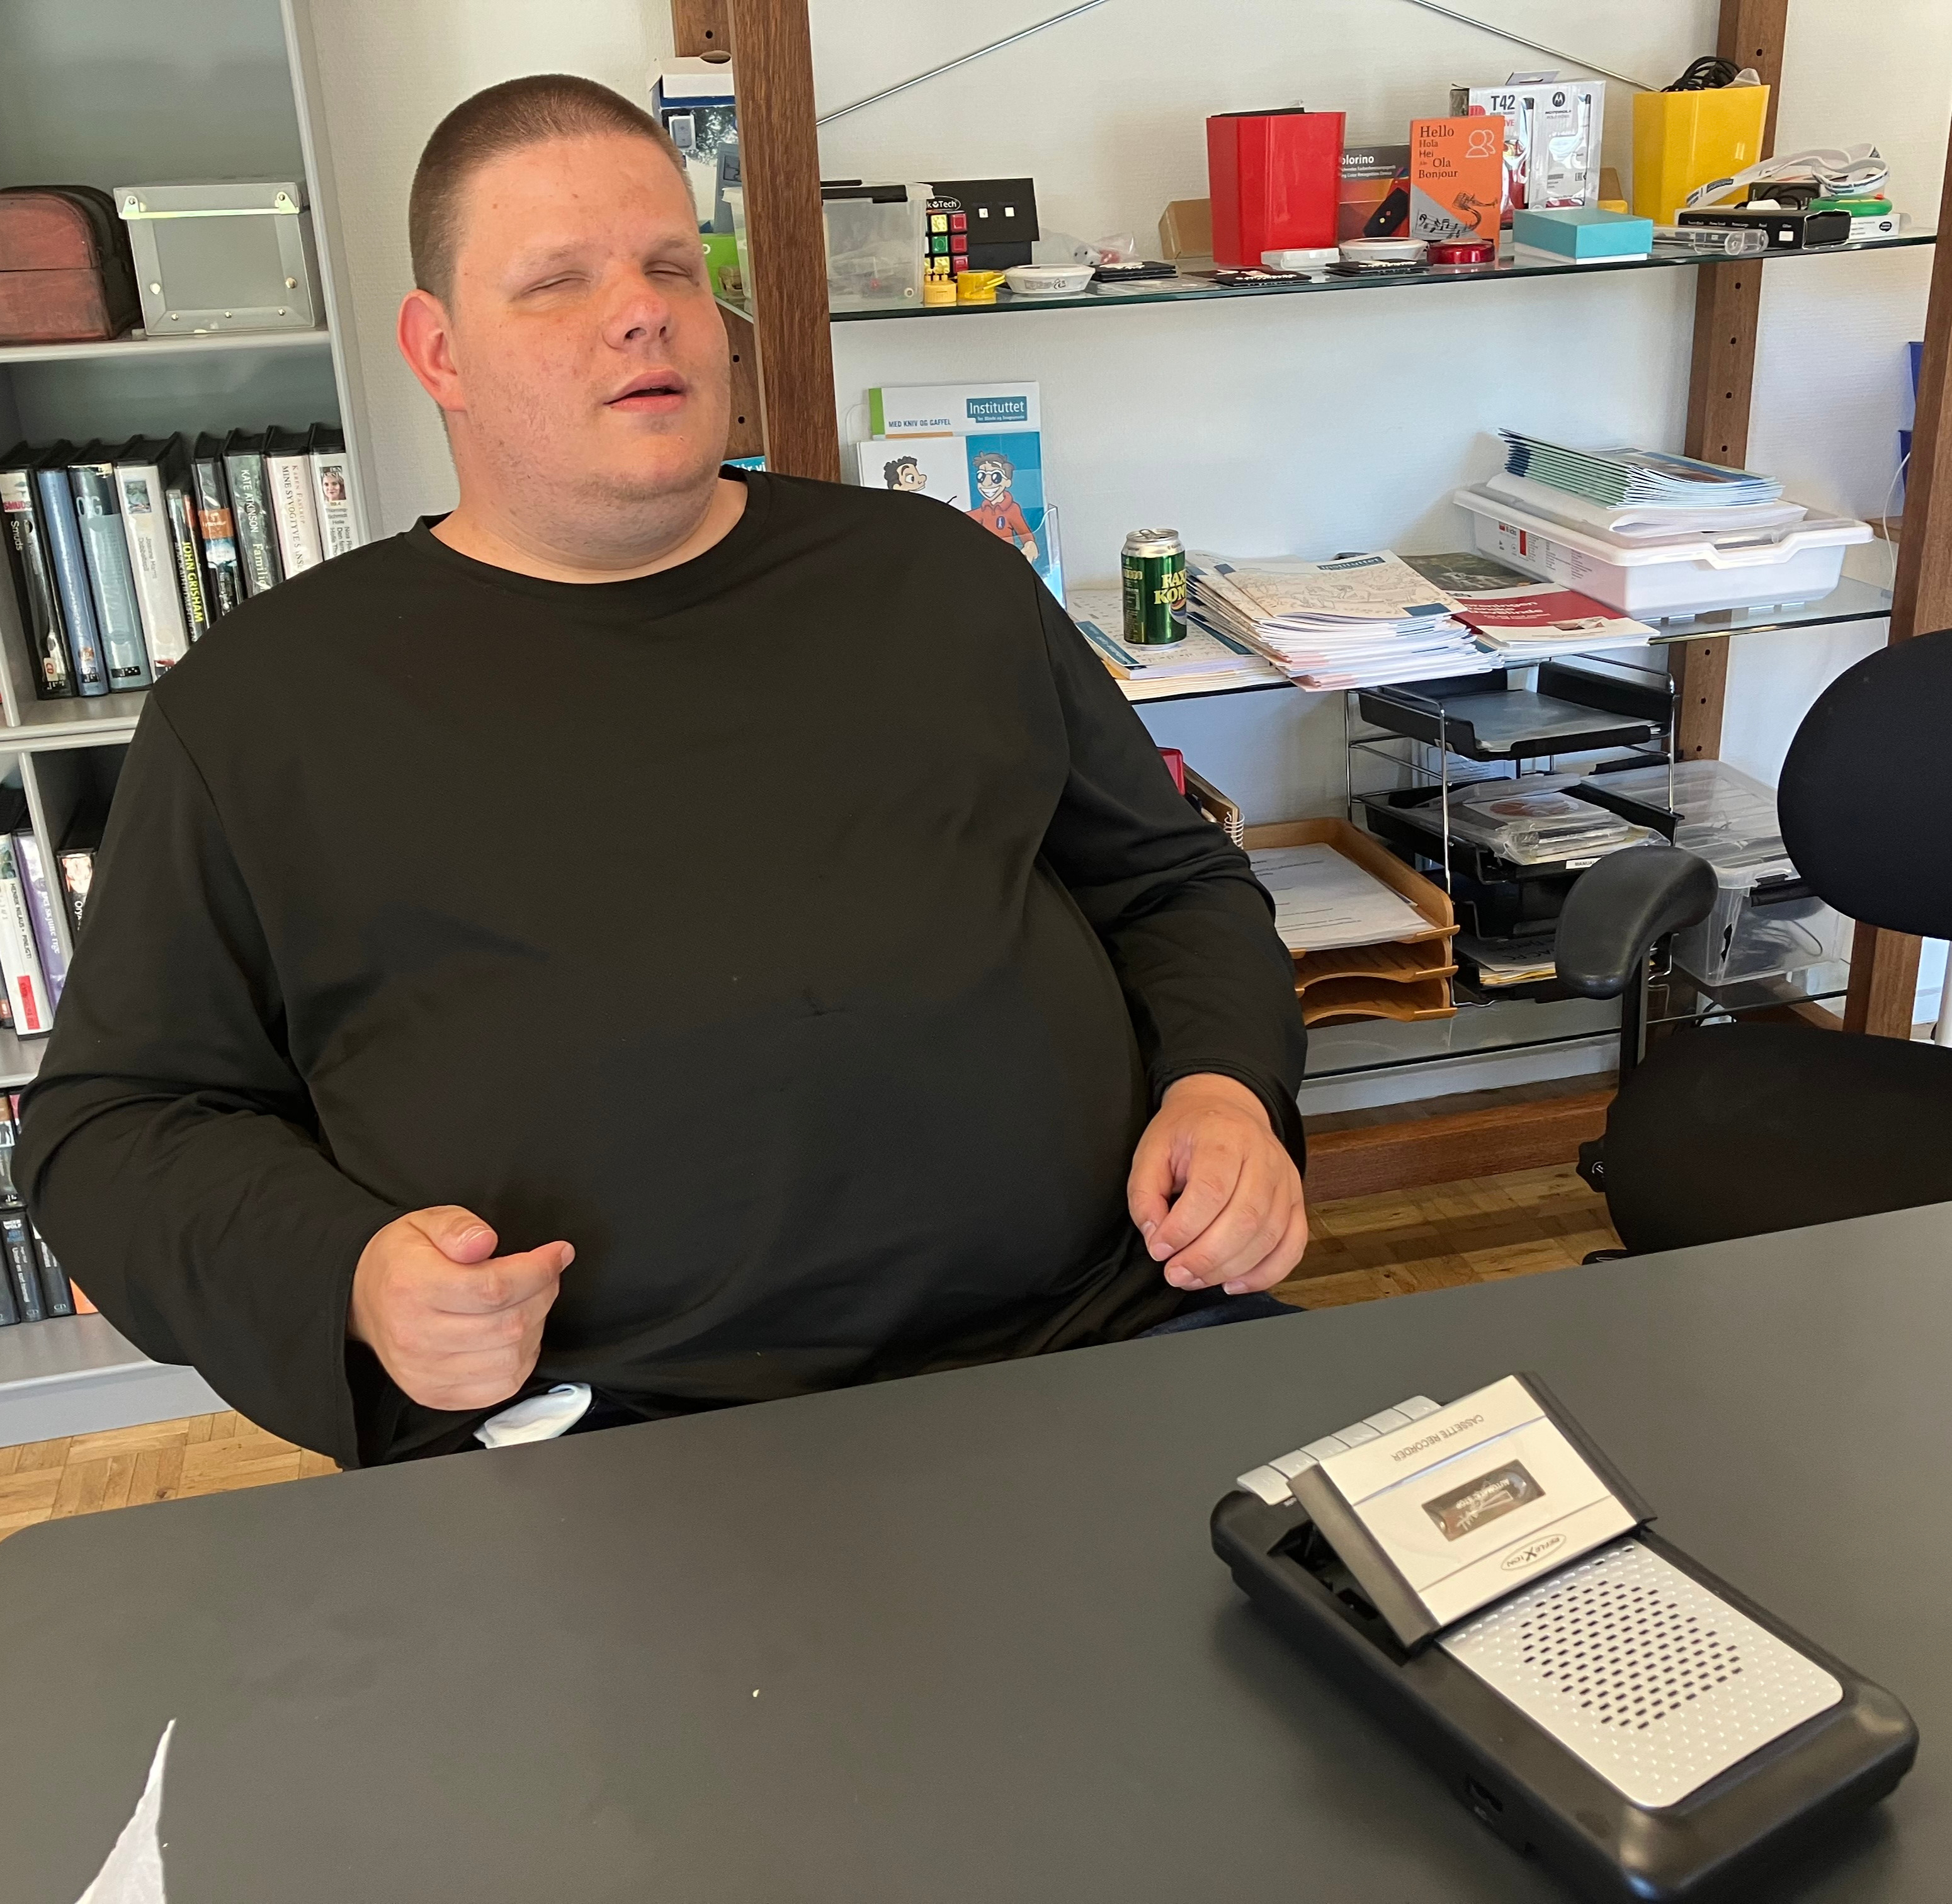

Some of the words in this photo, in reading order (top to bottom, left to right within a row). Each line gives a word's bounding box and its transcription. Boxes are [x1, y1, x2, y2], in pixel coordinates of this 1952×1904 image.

[1490, 94, 1516, 111] T42
[1420, 125, 1455, 138] Hello
[1419, 139, 1439, 148] Hola
[1419, 149, 1434, 158] Hei
[1433, 157, 1451, 167] Ola
[1418, 169, 1459, 180] Bonjour
[970, 401, 1025, 414] Instituttet
[919, 419, 929, 427] OG
[929, 418, 951, 426] GAFFEL
[241, 469, 253, 490] KATE
[282, 465, 292, 489] MINE
[245, 492, 259, 533] ATKINSON
[10, 520, 24, 552] Smuds
[181, 541, 196, 571] JOHN
[1321, 557, 1380, 570] Instituttet
[187, 572, 205, 623] GRISHAM
[26, 1308, 39, 1317] CD
[1438, 1414, 1485, 1439] CASSETTE
[1390, 1433, 1442, 1463] RECORDER
